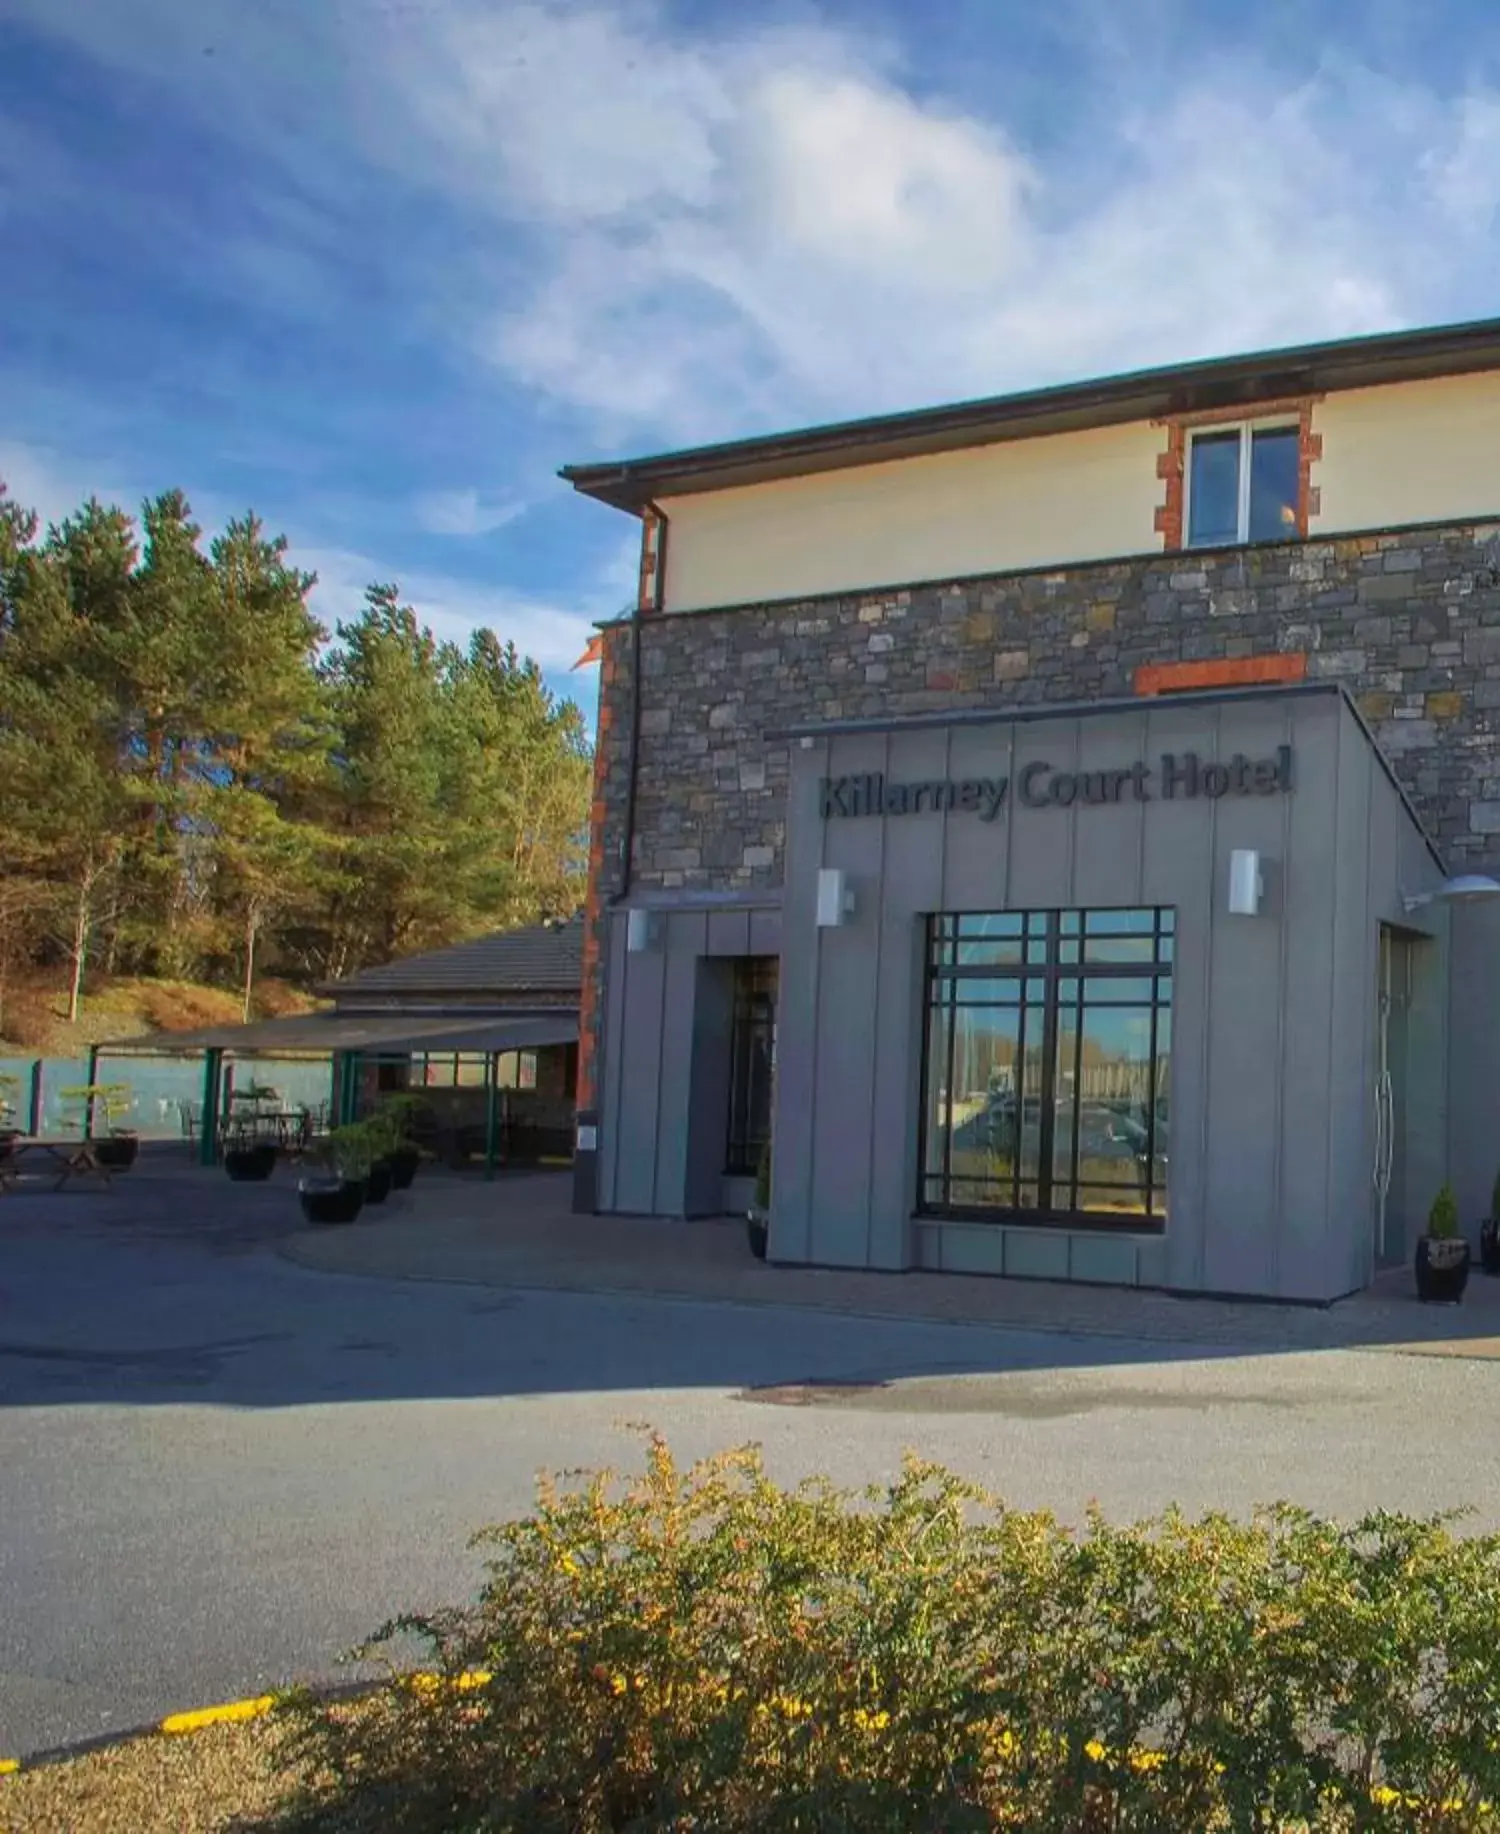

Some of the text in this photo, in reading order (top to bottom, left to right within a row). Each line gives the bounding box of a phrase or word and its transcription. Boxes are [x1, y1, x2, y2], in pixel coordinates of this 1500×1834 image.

[820, 745, 1294, 822] Killarney Court Hotel
